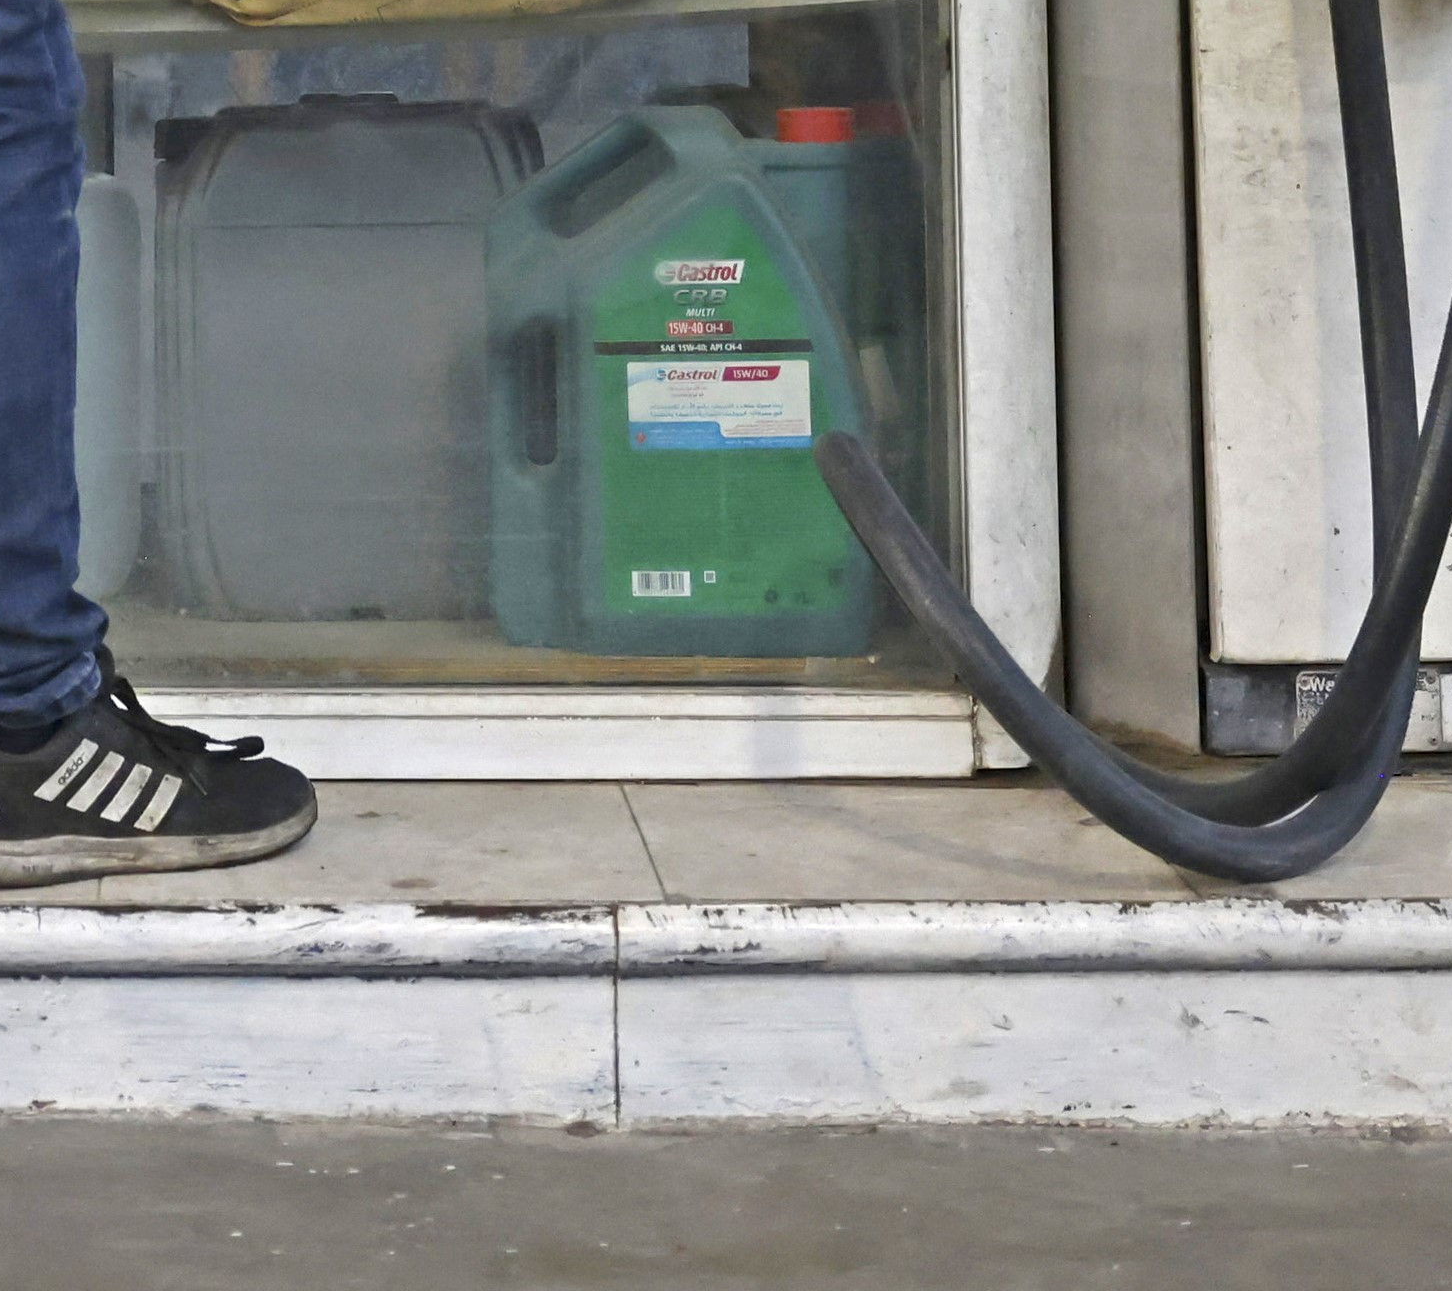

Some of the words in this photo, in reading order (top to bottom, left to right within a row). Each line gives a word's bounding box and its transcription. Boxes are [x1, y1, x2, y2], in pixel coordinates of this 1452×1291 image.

[676, 262, 739, 283] Castrol
[672, 288, 728, 306] CRB
[685, 307, 716, 317] MULTI
[668, 321, 704, 335] 15W-40
[705, 322, 724, 333] CH-4
[659, 344, 677, 352] SAE
[709, 343, 723, 352] API
[724, 343, 743, 351] CH-4
[667, 368, 718, 381] Castrol
[732, 368, 769, 379] 15W/40
